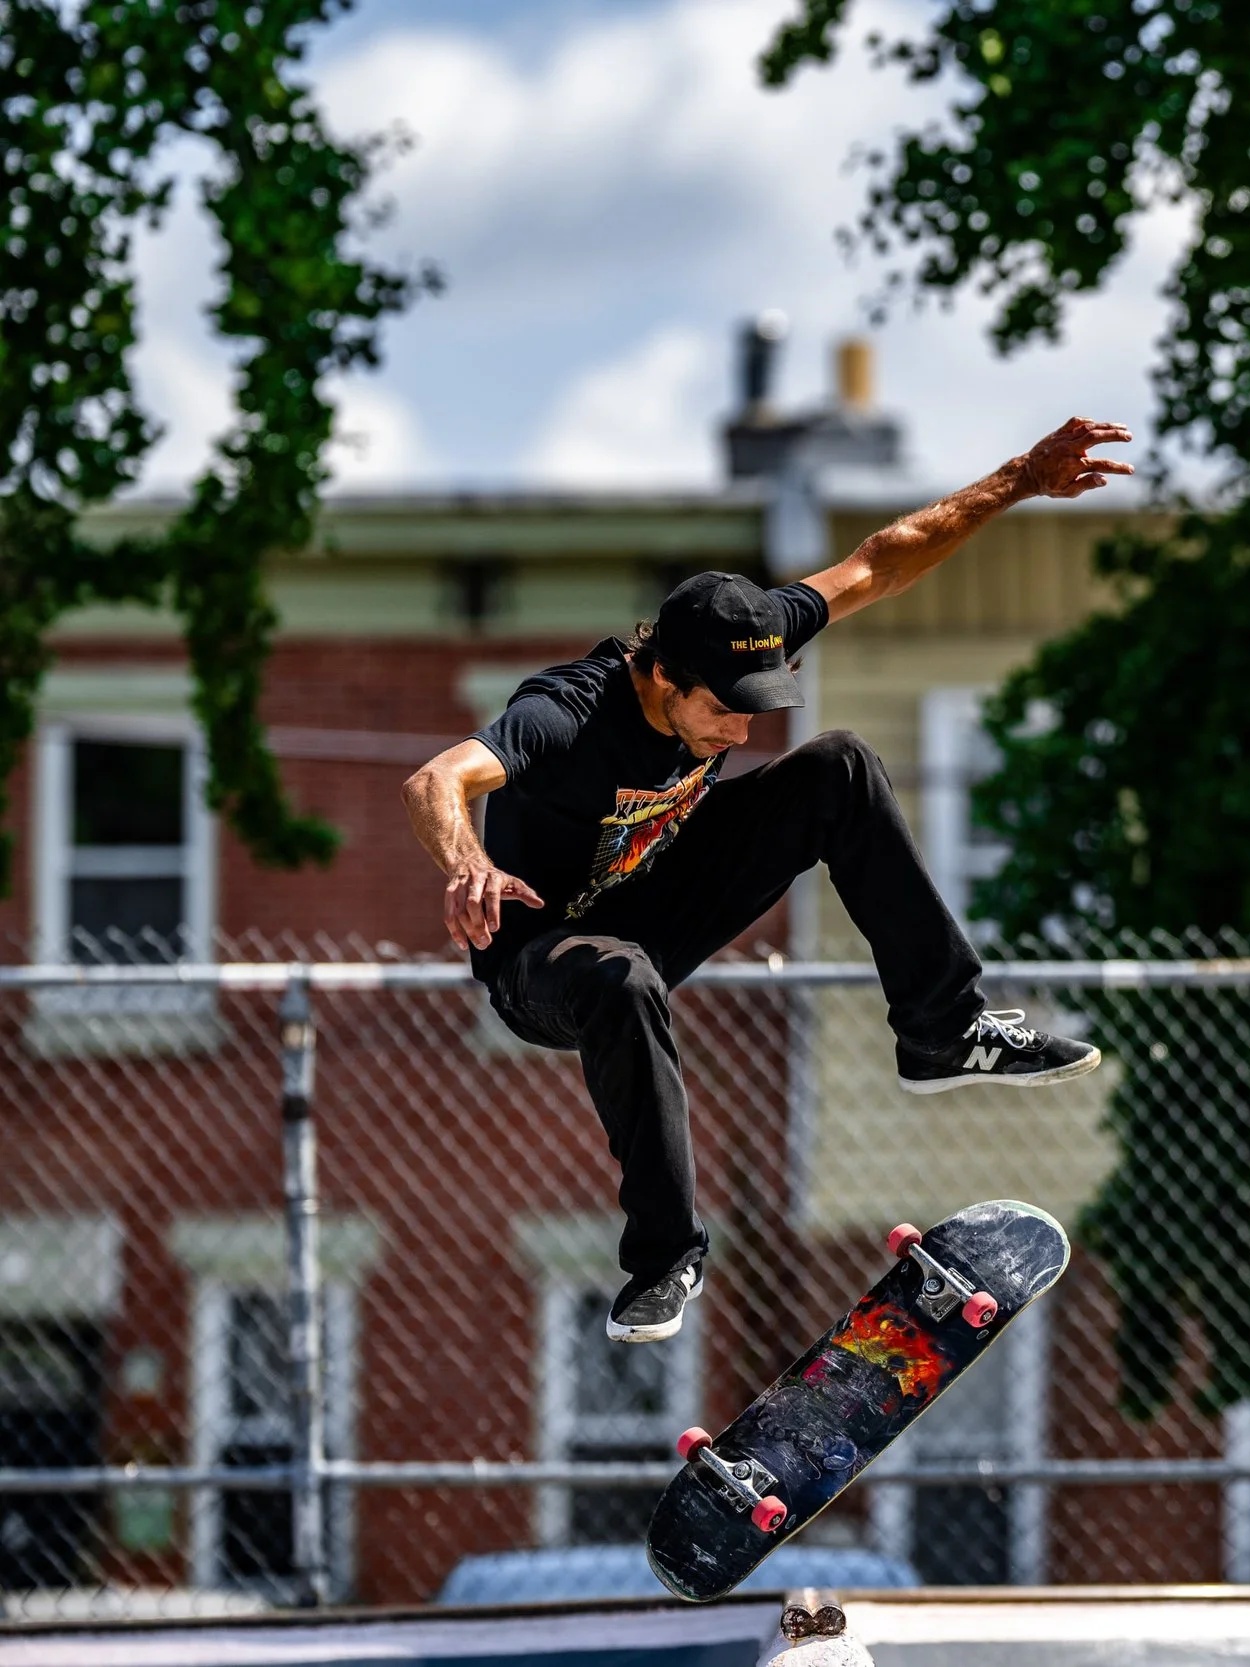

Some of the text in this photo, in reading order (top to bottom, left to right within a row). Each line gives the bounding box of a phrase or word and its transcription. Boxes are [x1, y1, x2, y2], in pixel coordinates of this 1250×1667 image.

[730, 640, 748, 650] THE
[749, 636, 769, 651] LION
[962, 1045, 1003, 1071] N
